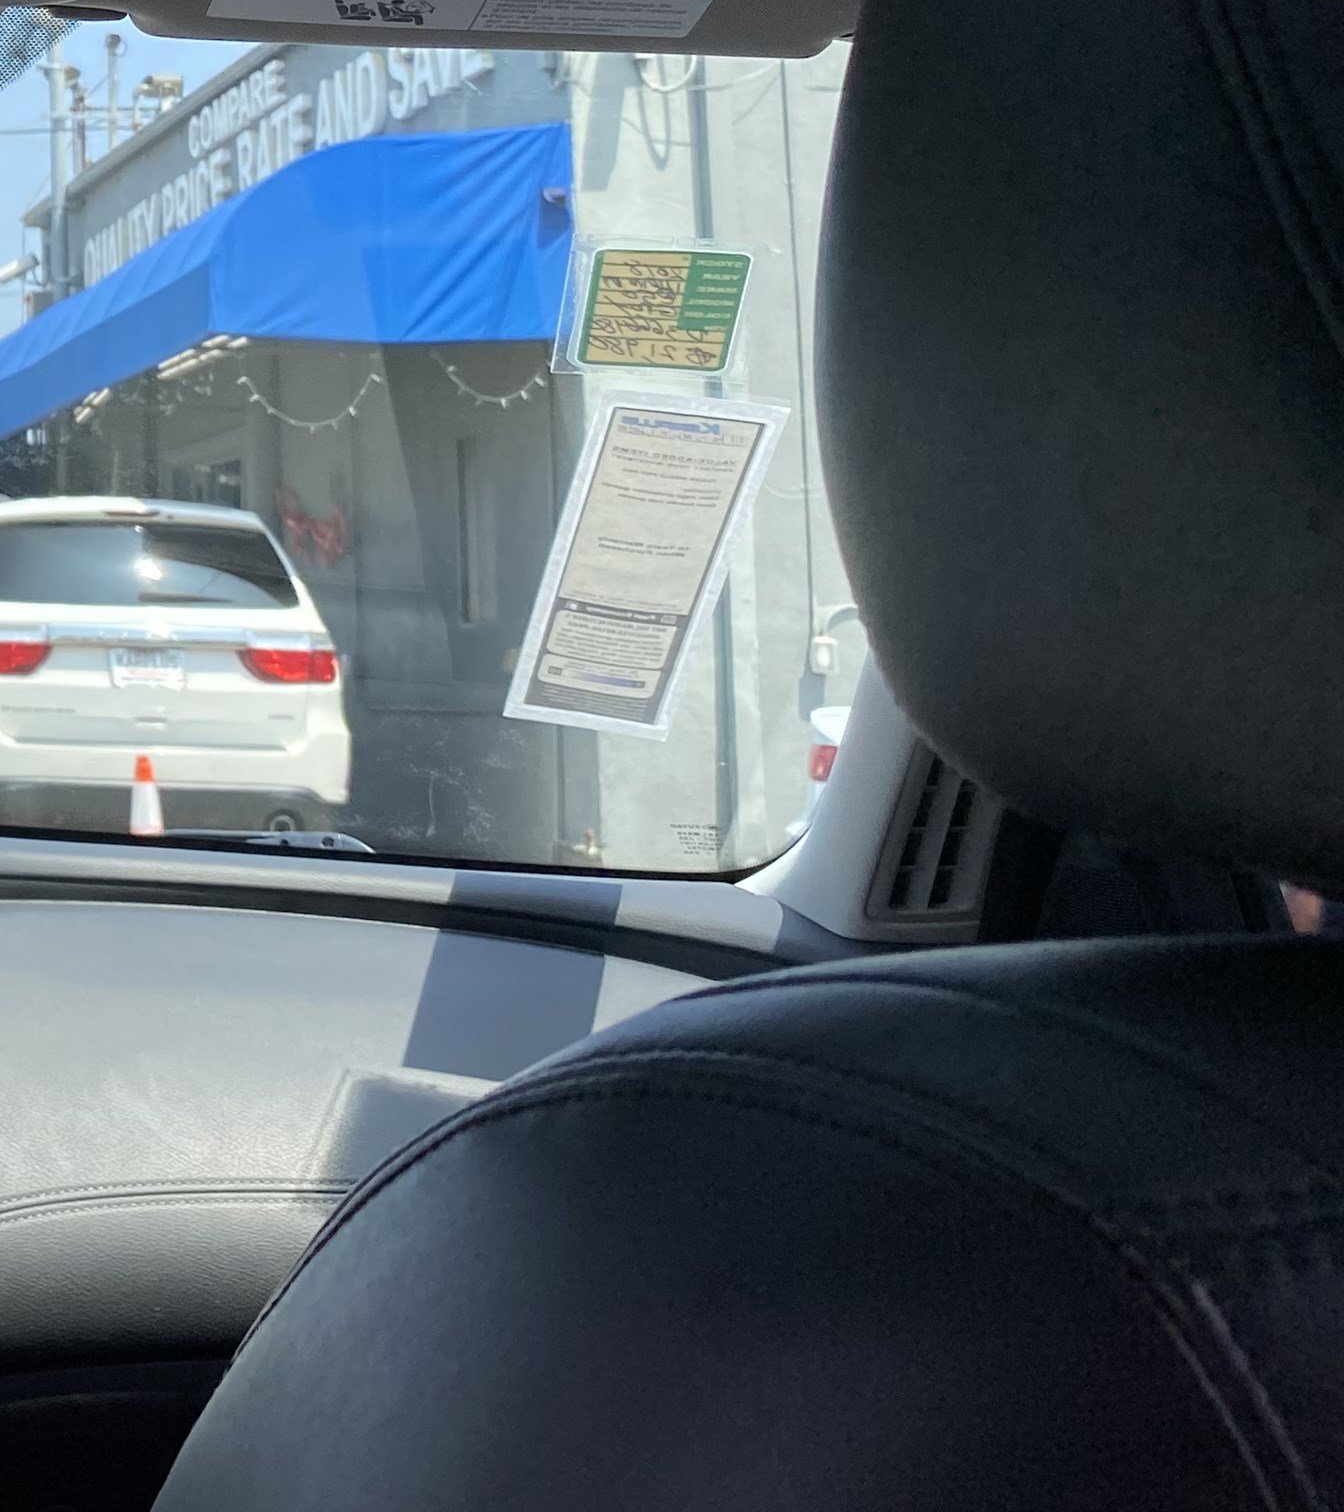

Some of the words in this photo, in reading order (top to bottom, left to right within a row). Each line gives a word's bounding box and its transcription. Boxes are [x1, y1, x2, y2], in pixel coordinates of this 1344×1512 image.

[83, 192, 160, 290] QUALITY
[161, 147, 234, 238] PRICE
[235, 93, 313, 191] RATE
[314, 49, 388, 151] AND
[188, 59, 287, 159] COMPARE
